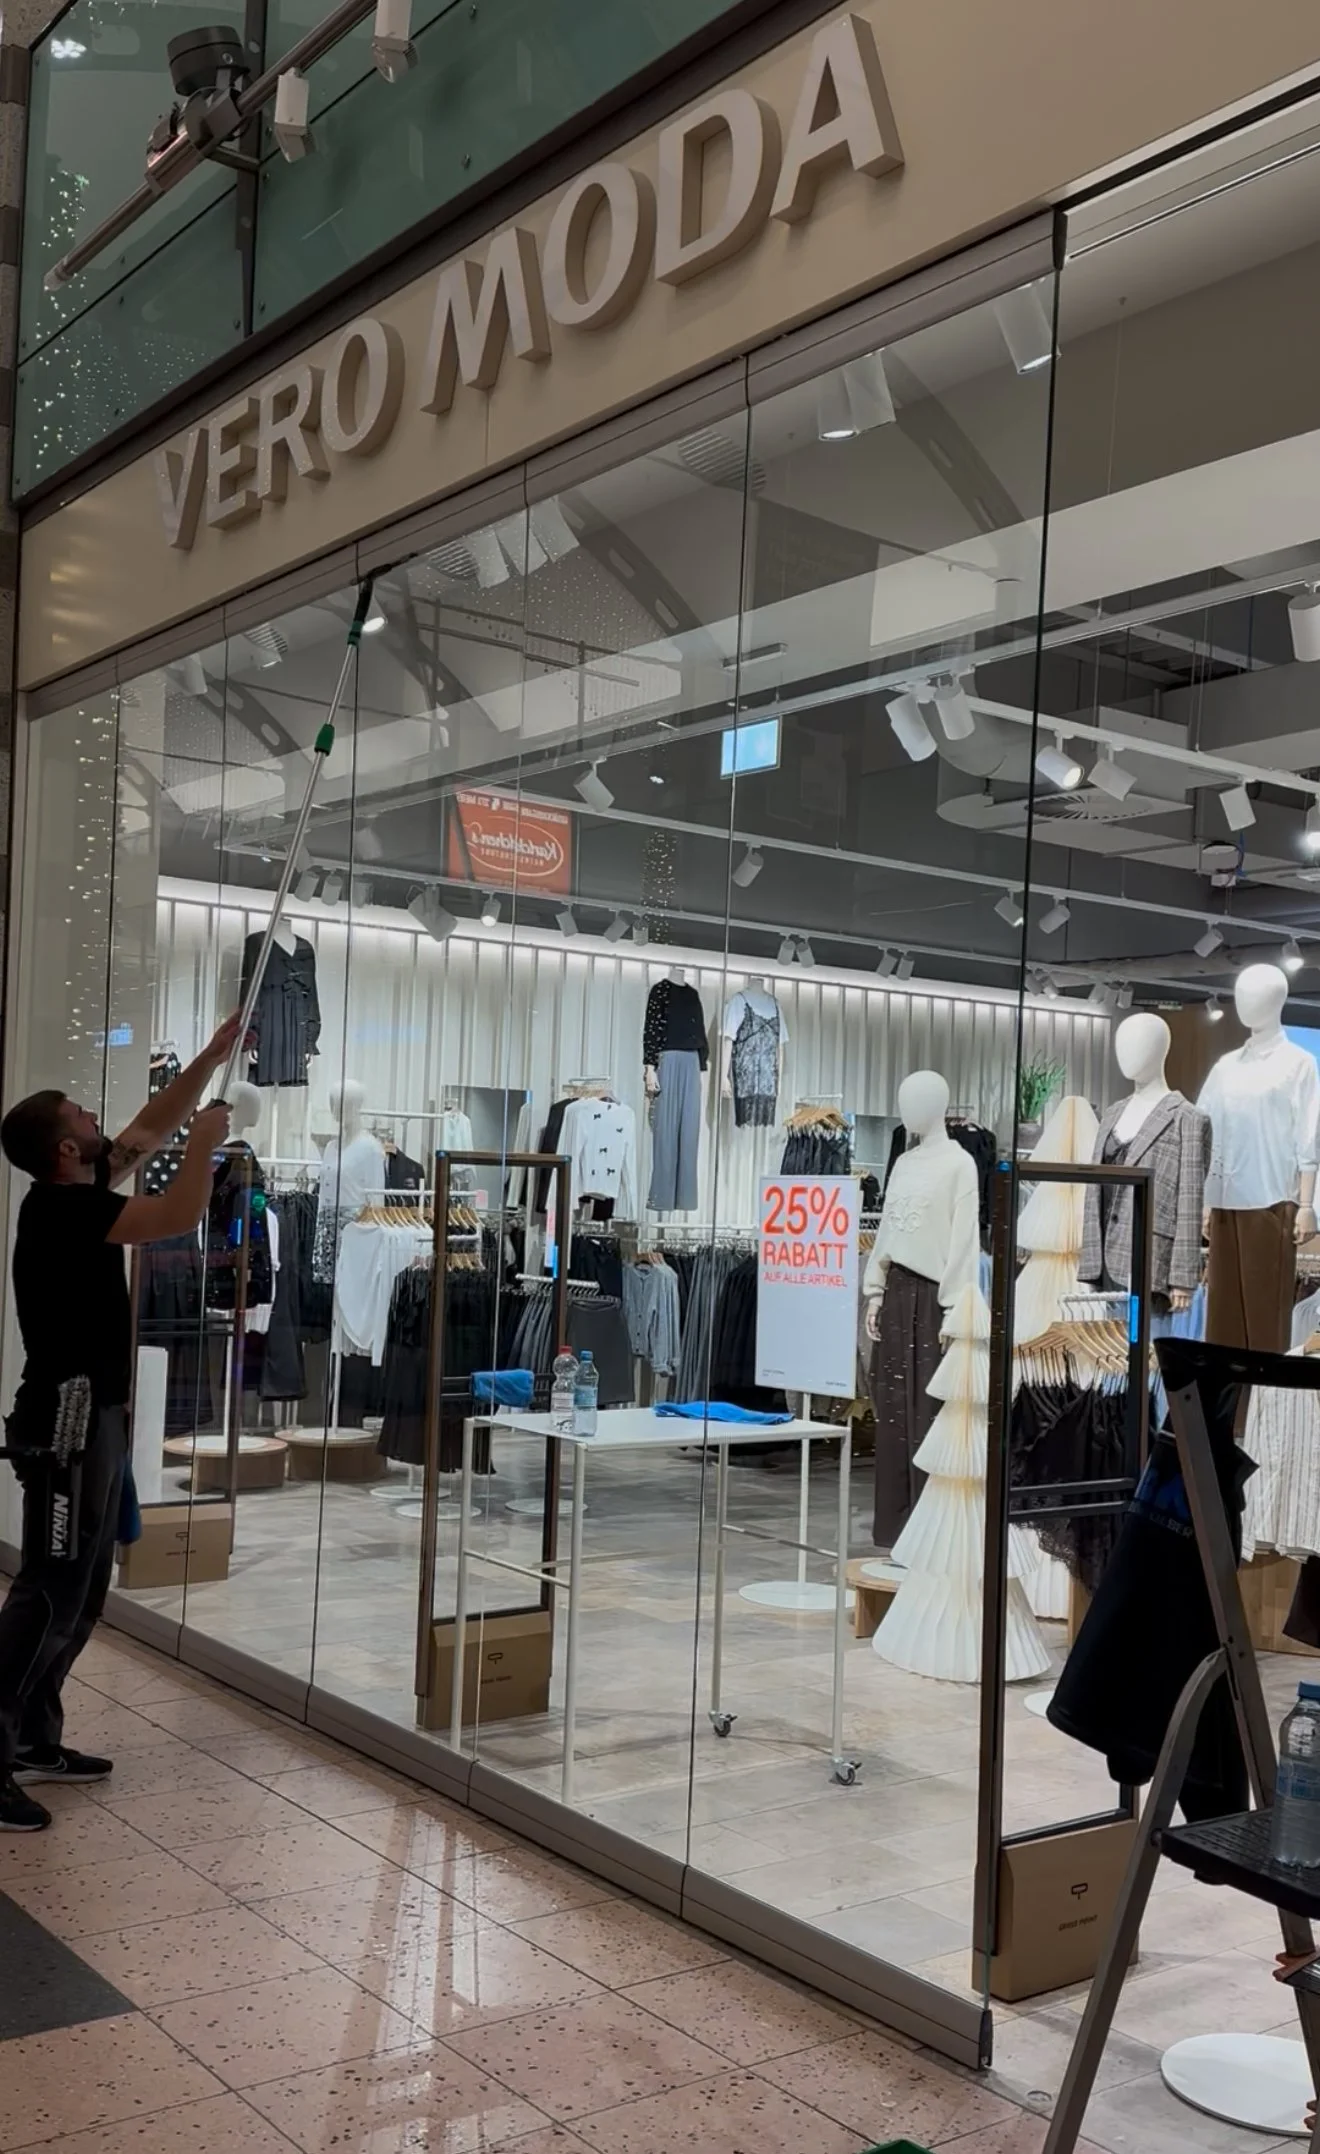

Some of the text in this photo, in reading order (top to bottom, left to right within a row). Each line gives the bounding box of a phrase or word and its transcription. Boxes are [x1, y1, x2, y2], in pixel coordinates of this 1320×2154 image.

[155, 13, 905, 550] VERO MODA
[764, 1186, 849, 1236] 25%
[763, 1241, 848, 1269] RABATT
[763, 1271, 847, 1287] AUF ALLE ARTIKEL
